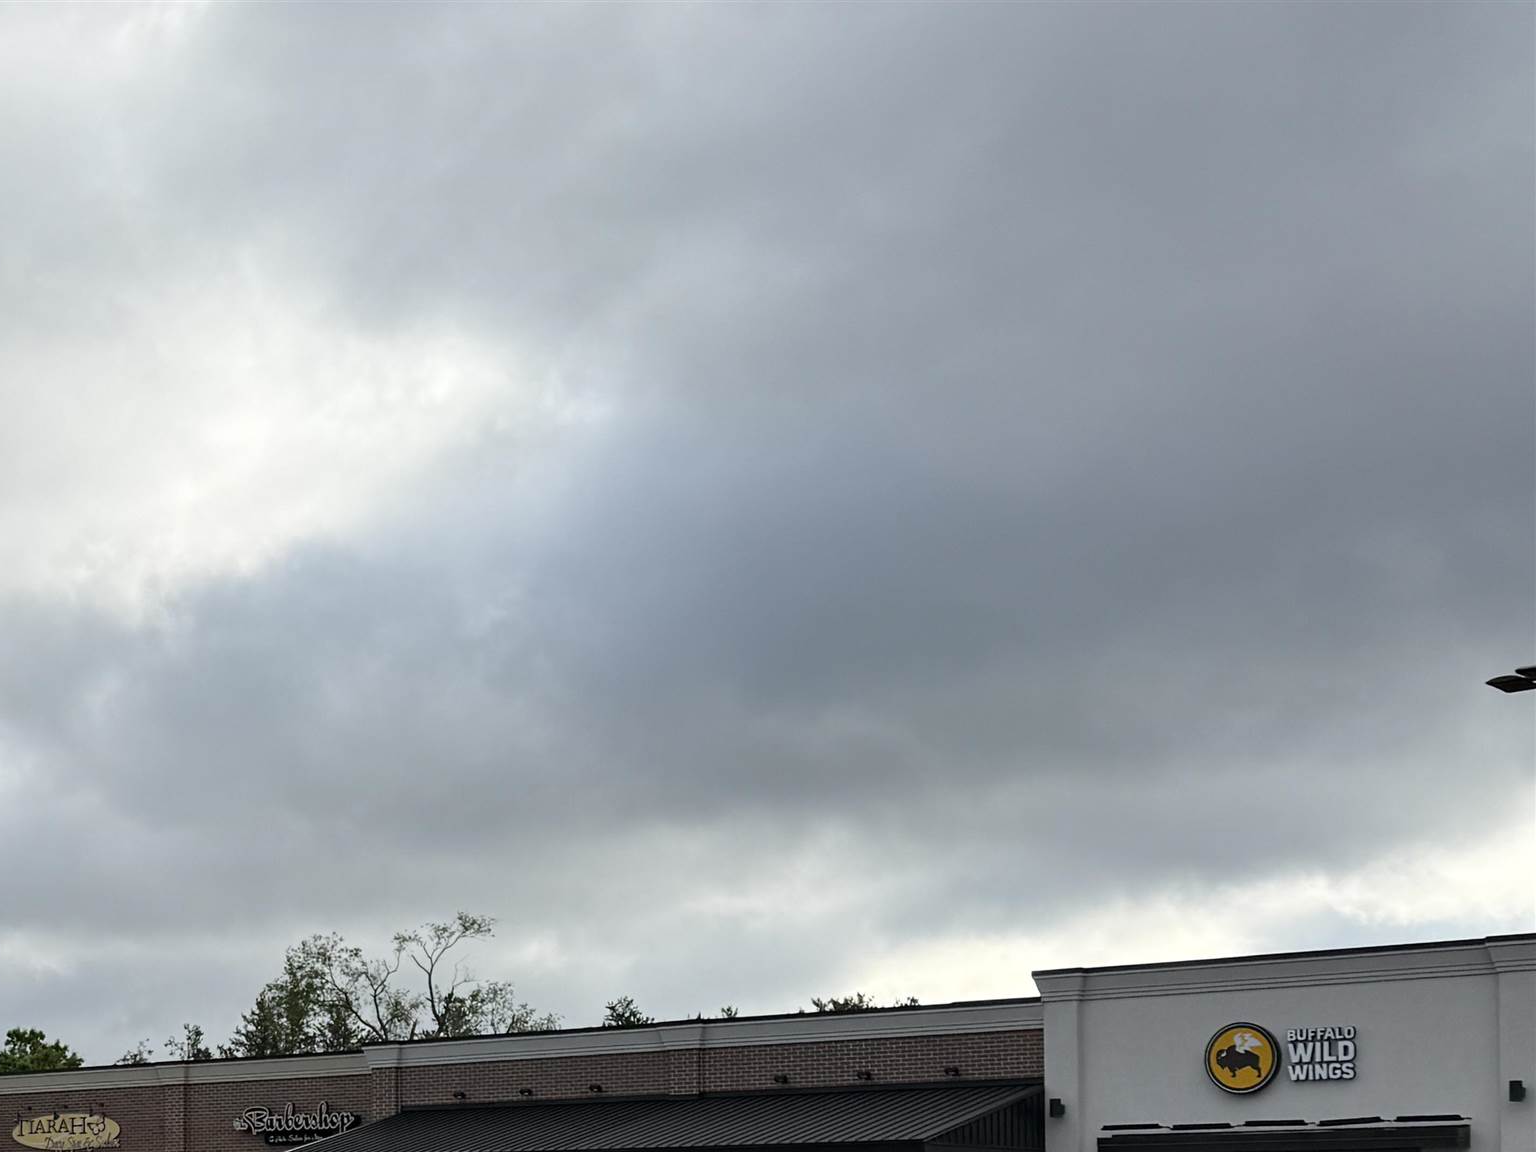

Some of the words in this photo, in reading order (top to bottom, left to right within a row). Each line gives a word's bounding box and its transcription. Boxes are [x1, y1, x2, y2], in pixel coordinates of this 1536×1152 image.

[1287, 1026, 1355, 1041] BUFFALO
[1288, 1040, 1356, 1063] WILD
[1288, 1062, 1356, 1081] WINGS
[243, 1101, 355, 1135] Barbershop
